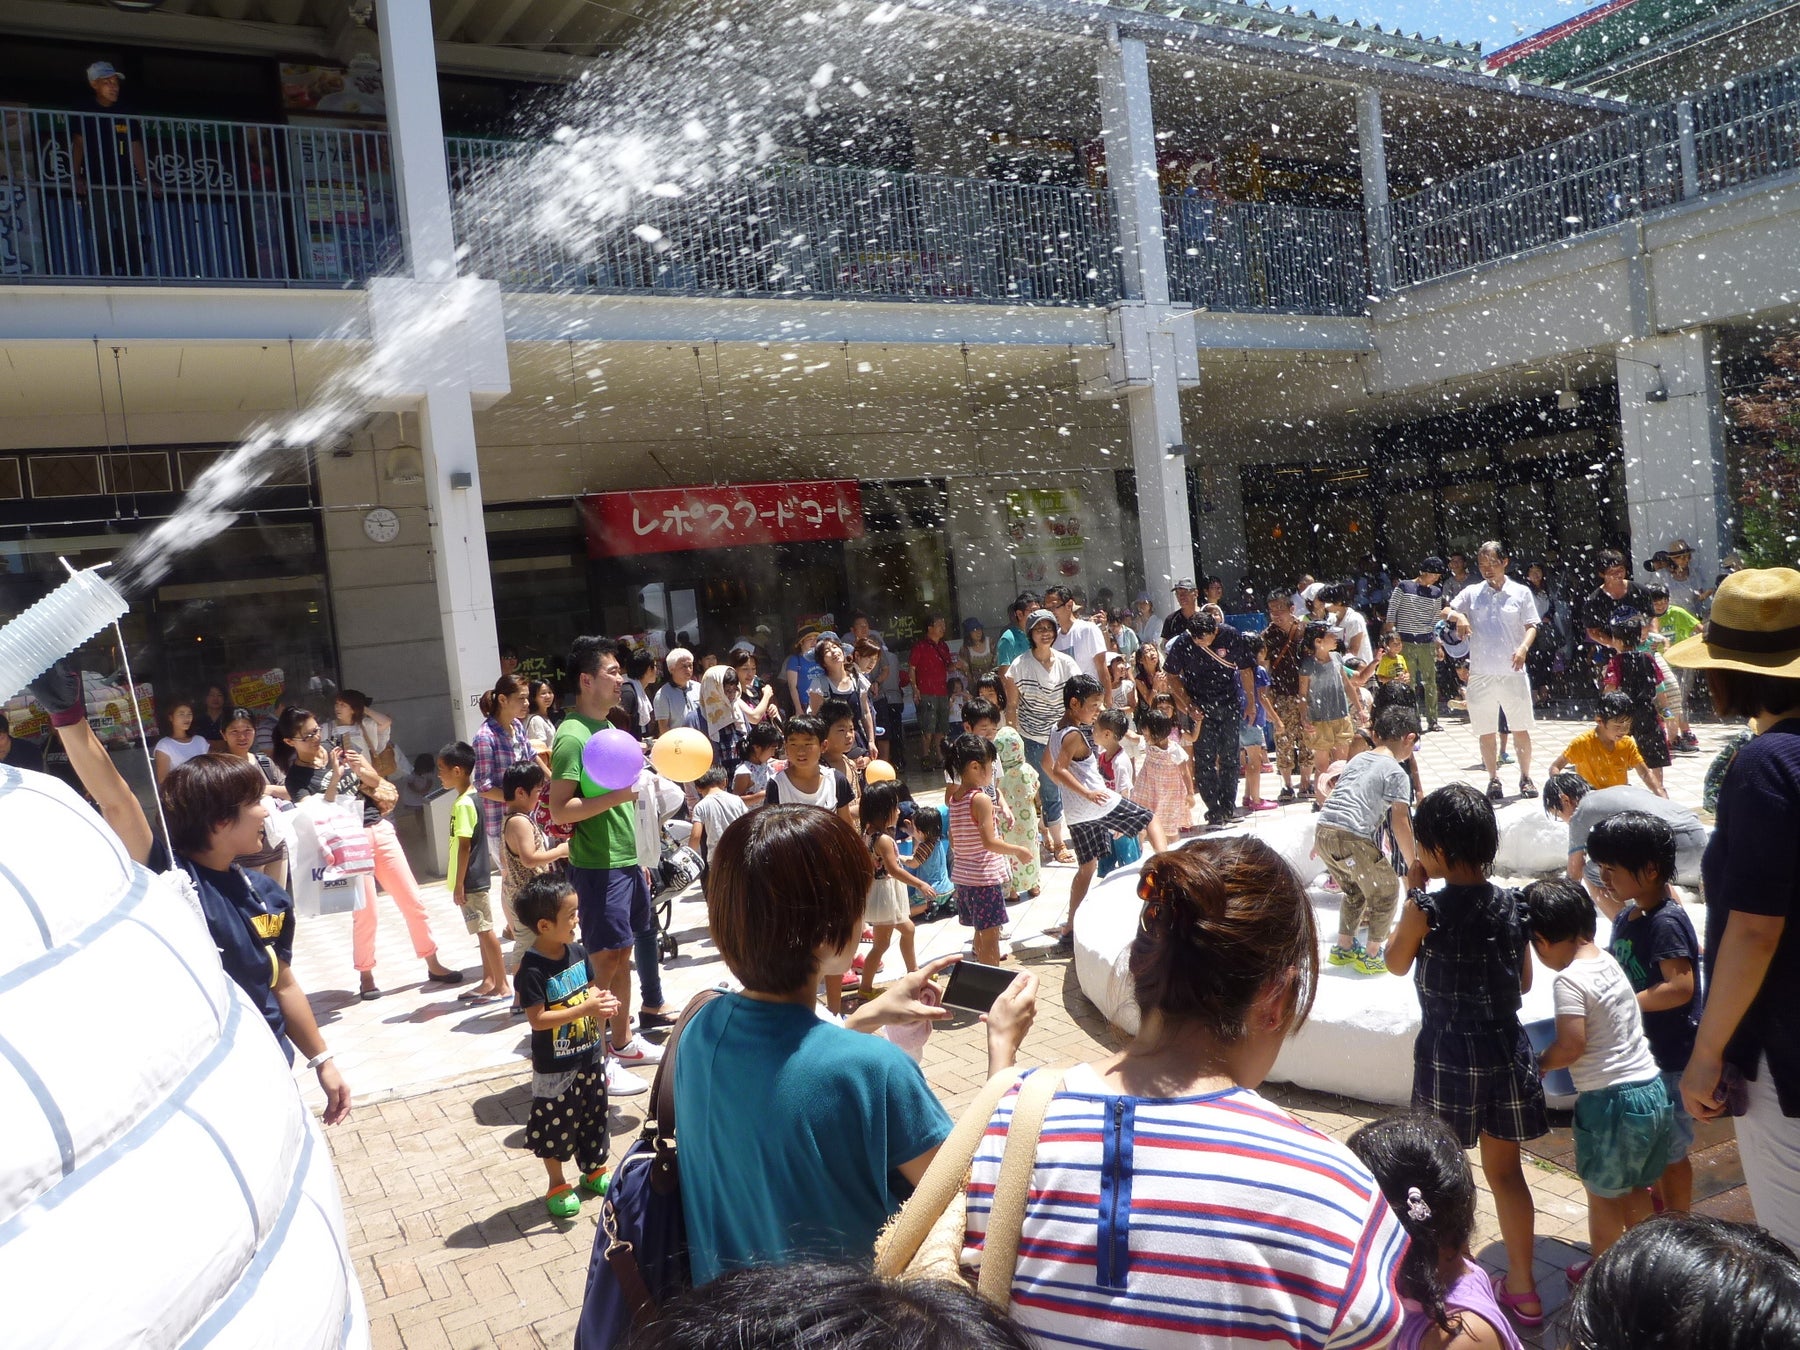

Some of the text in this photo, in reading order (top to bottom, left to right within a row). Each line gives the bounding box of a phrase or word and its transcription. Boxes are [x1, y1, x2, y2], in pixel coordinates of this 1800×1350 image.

[632, 498, 852, 536] レポスフードコート
[324, 878, 348, 887] SPORTS
[555, 1047, 575, 1057] BABY
